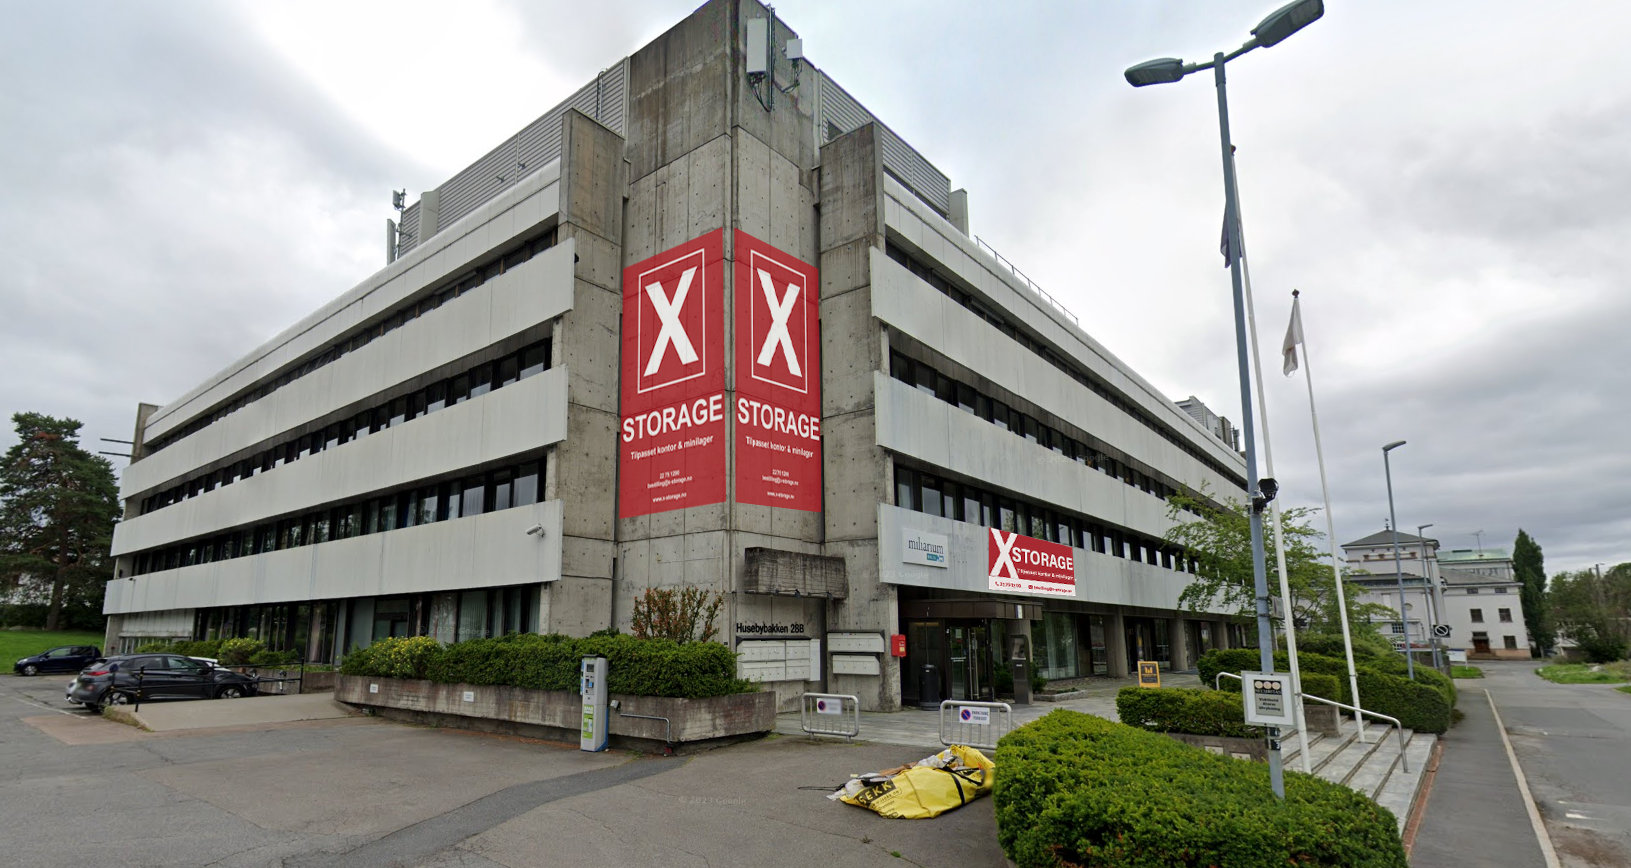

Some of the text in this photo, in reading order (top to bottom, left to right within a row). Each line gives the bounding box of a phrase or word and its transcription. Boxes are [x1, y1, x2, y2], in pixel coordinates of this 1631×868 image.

[643, 266, 699, 377] X
[756, 268, 802, 378] X
[623, 394, 723, 442] STORAGE
[738, 398, 820, 440] STORAGE
[631, 436, 713, 460] Tilpasset kontor & minilager
[736, 623, 804, 634] Husebybakken 28B
